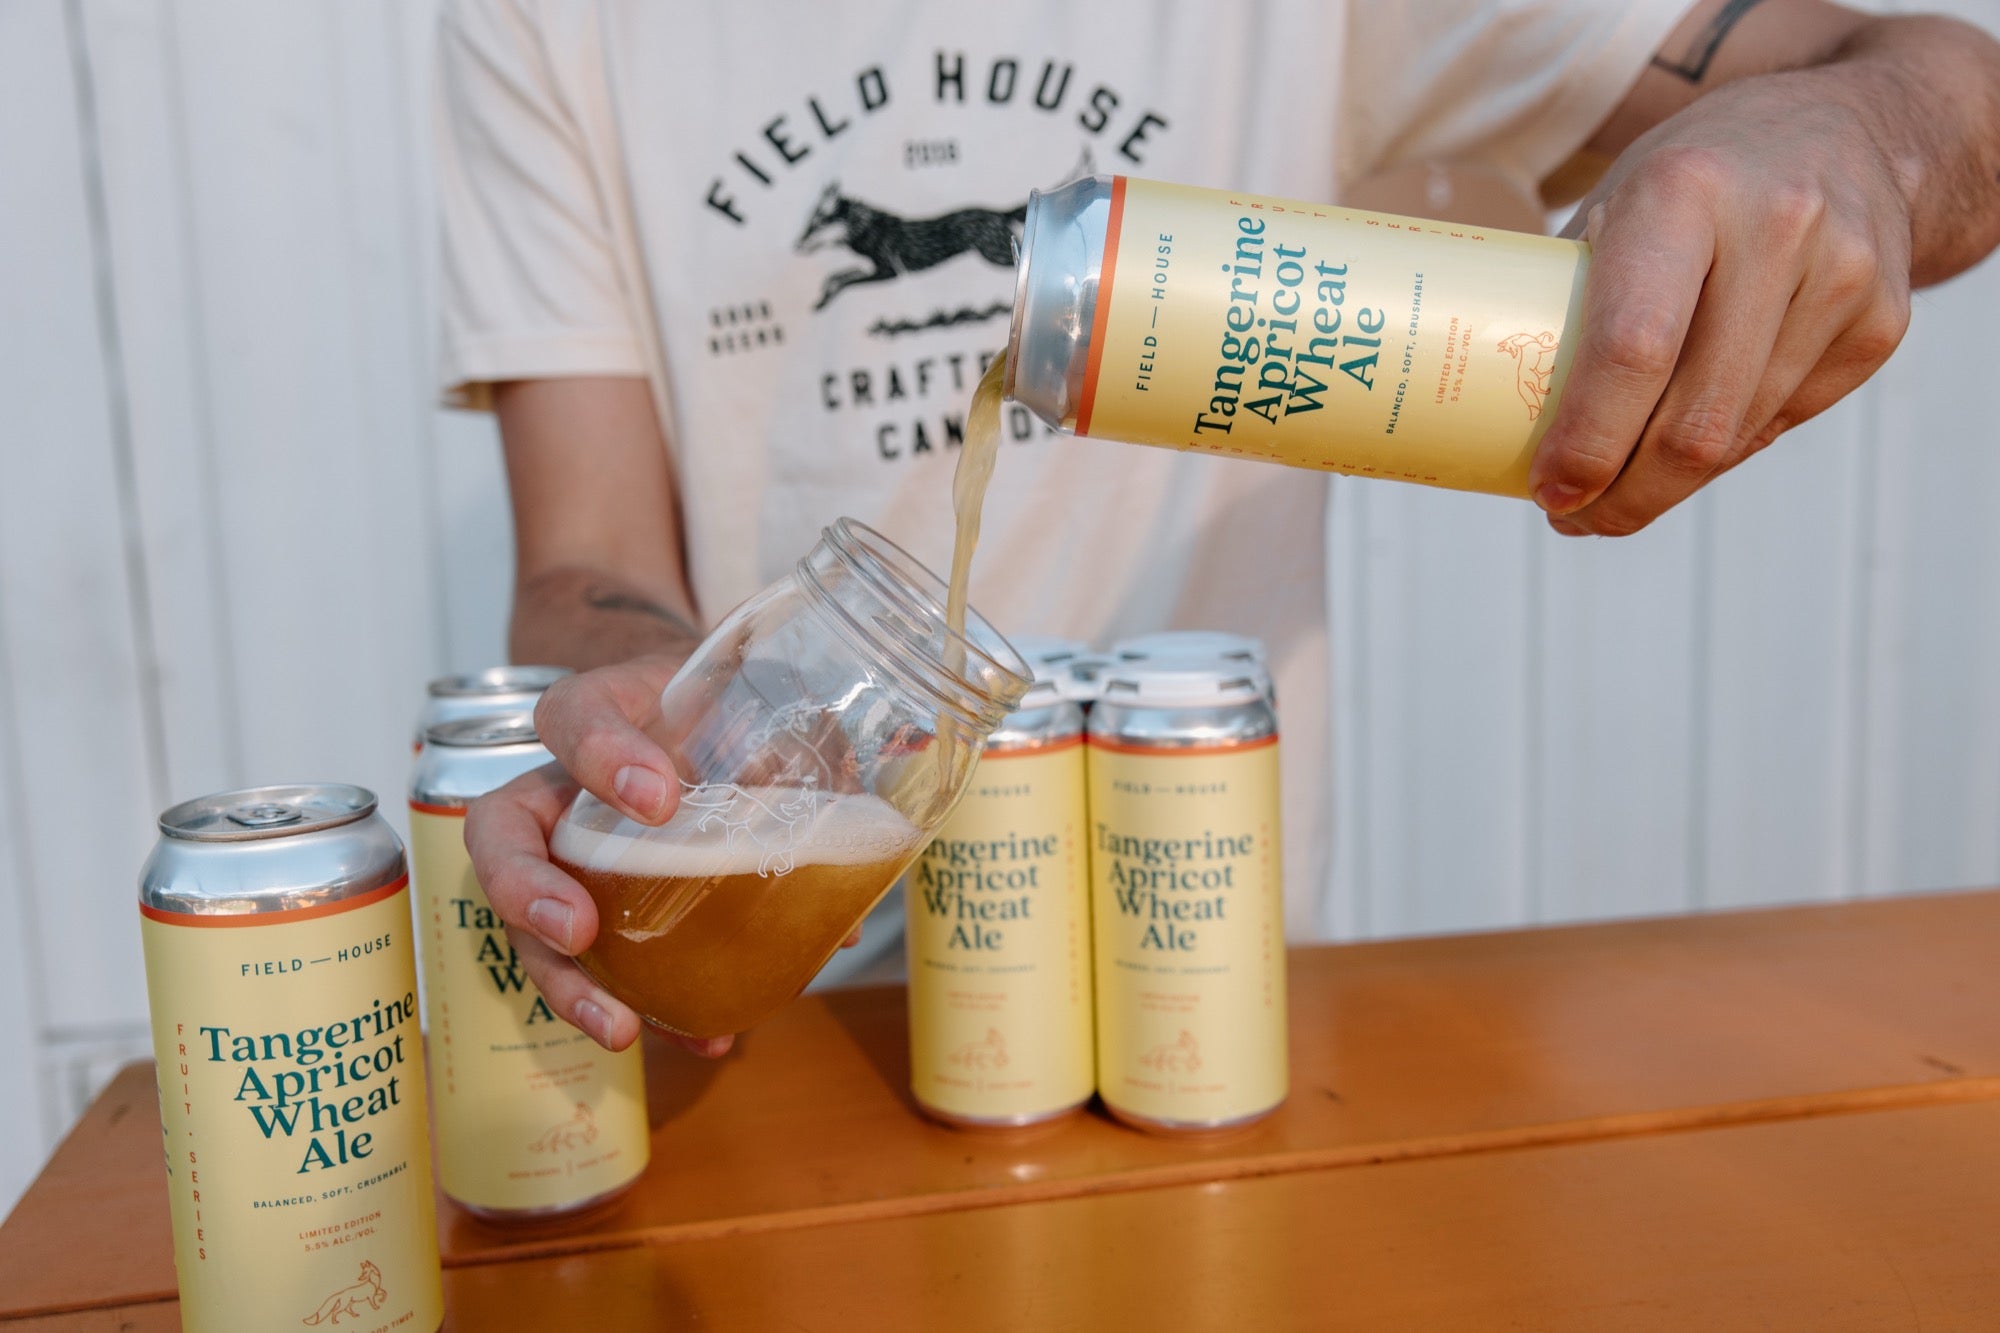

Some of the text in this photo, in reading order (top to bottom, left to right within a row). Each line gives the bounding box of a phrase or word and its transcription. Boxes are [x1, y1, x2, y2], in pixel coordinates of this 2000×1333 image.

[706, 51, 1170, 226] FIELD HOUSE
[1230, 199, 1485, 242] FRUIT SERIES
[1136, 232, 1173, 392] FIELD HOUSE
[1194, 215, 1267, 435] Tangerine
[1243, 243, 1307, 425] Apricot
[1284, 259, 1349, 417] Wheat
[1338, 306, 1386, 392] Ale
[1386, 272, 1424, 435] BALANCED, SOFT, CRUSHABLE
[1435, 317, 1459, 405] LIMITED EDITION
[1451, 378, 1463, 402] 5.5%
[922, 831, 1059, 867] ngerine
[1096, 822, 1254, 866] Tangerine
[917, 861, 1039, 899] Apricot
[1109, 859, 1233, 899] Apricot
[924, 889, 1032, 921] Wheat
[1115, 887, 1226, 920] Wheat
[241, 933, 393, 977] FIELD HOUSE
[949, 922, 1004, 951] Ale
[1140, 922, 1197, 951] Ale
[200, 991, 415, 1066] Tangerine
[234, 1034, 406, 1111] Apricot
[247, 1075, 401, 1140] Wheat
[177, 1023, 206, 1261] FRUIT SERIES
[296, 1129, 374, 1175] Ale
[253, 1161, 408, 1209] BALANCED, SOFT, CRUSHABLE
[299, 1210, 382, 1240] LIMITED EDITION
[304, 1240, 329, 1252] 5.5%
